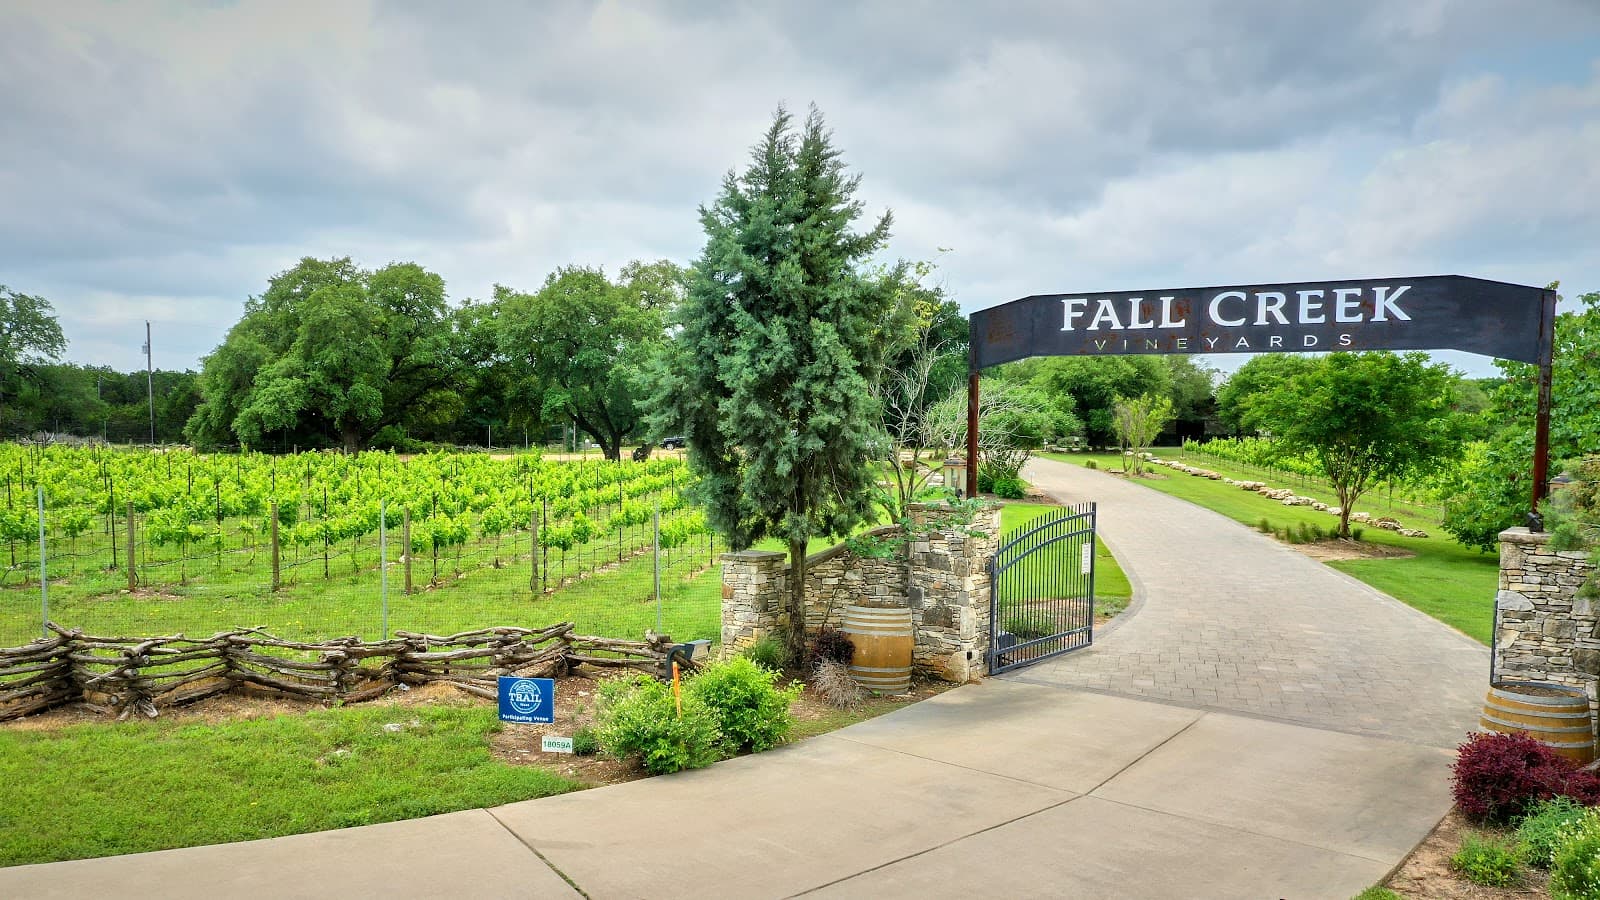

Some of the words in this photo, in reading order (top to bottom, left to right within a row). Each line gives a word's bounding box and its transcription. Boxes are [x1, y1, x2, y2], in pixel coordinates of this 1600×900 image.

[1060, 297, 1186, 331] FALL
[1208, 286, 1412, 327] CREEK
[1094, 334, 1352, 351] VINEYARDS
[509, 693, 541, 702] TRAIL
[543, 741, 571, 749] 18059A
